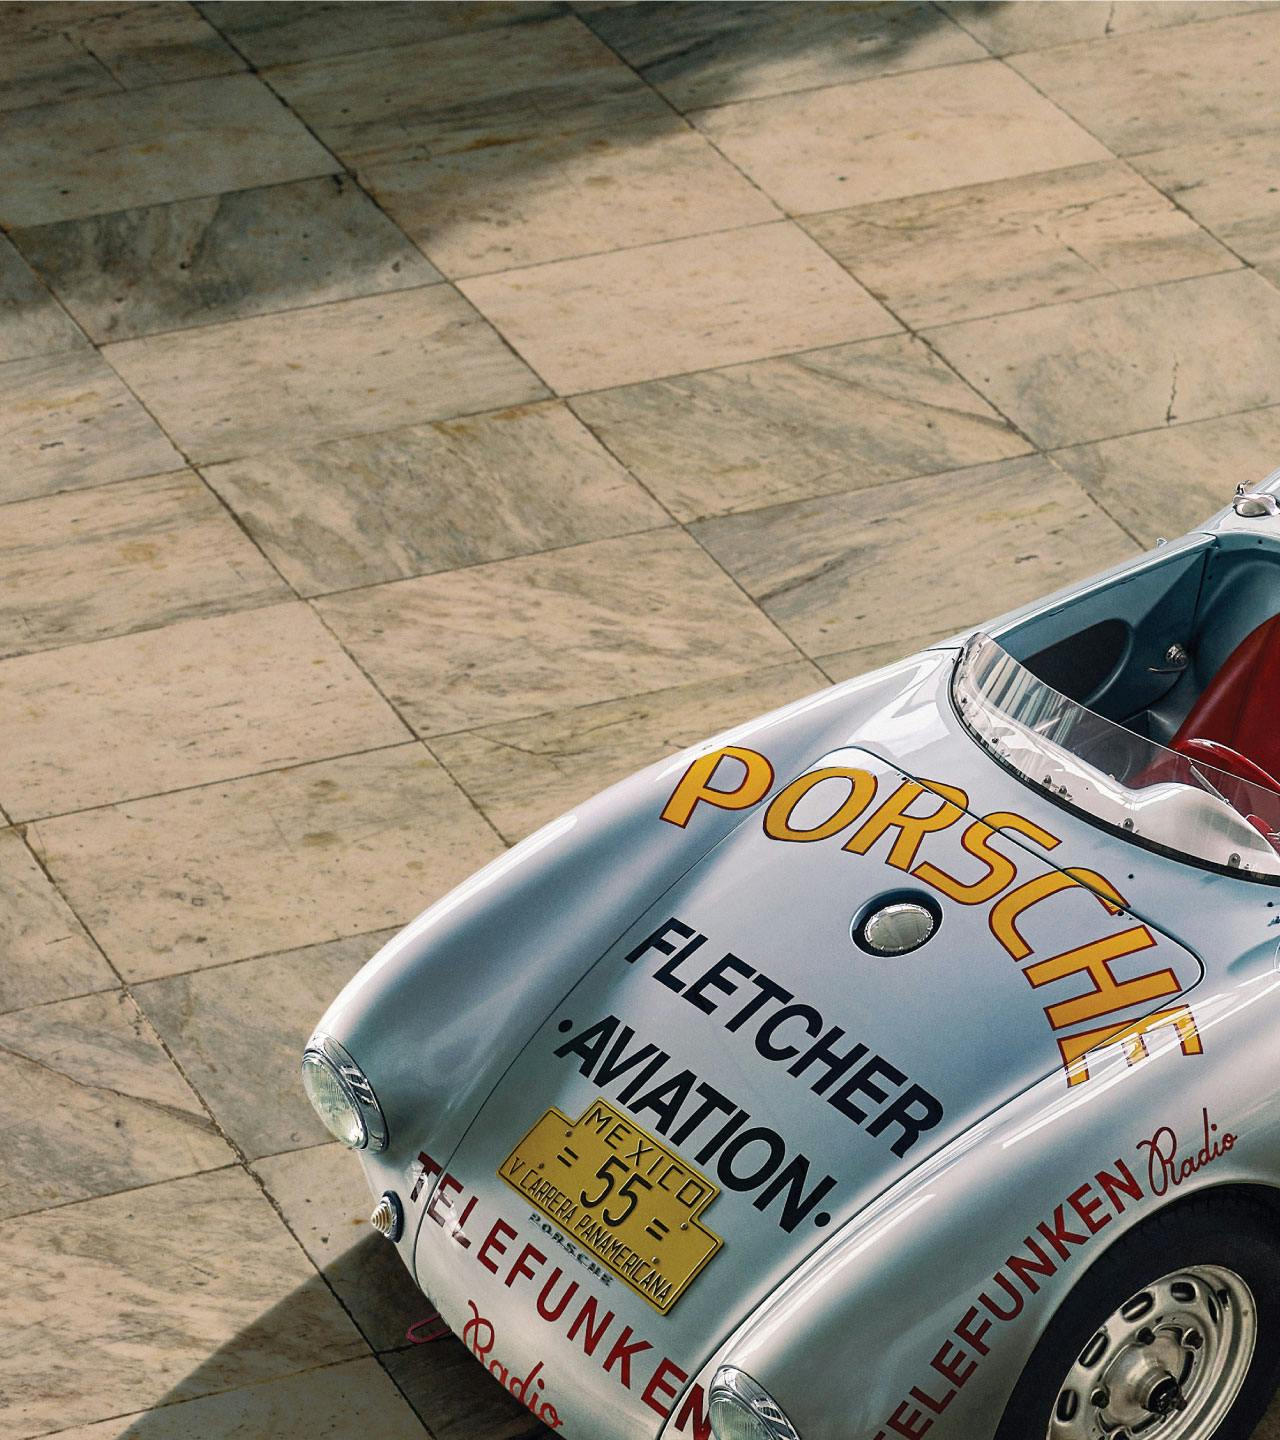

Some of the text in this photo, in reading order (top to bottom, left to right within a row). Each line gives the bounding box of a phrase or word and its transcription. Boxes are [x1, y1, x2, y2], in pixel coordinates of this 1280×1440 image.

[659, 745, 1204, 1088] PORSCHE
[624, 917, 944, 1159] FLETCHER
[580, 1154, 653, 1227] 55
[584, 1108, 705, 1209] MEXICO
[1136, 1108, 1238, 1197] Radio
[507, 1157, 674, 1304] V CARRERA PANAMERICANA
[528, 1213, 614, 1287] PORSCHE
[463, 1299, 564, 1429] Radio
